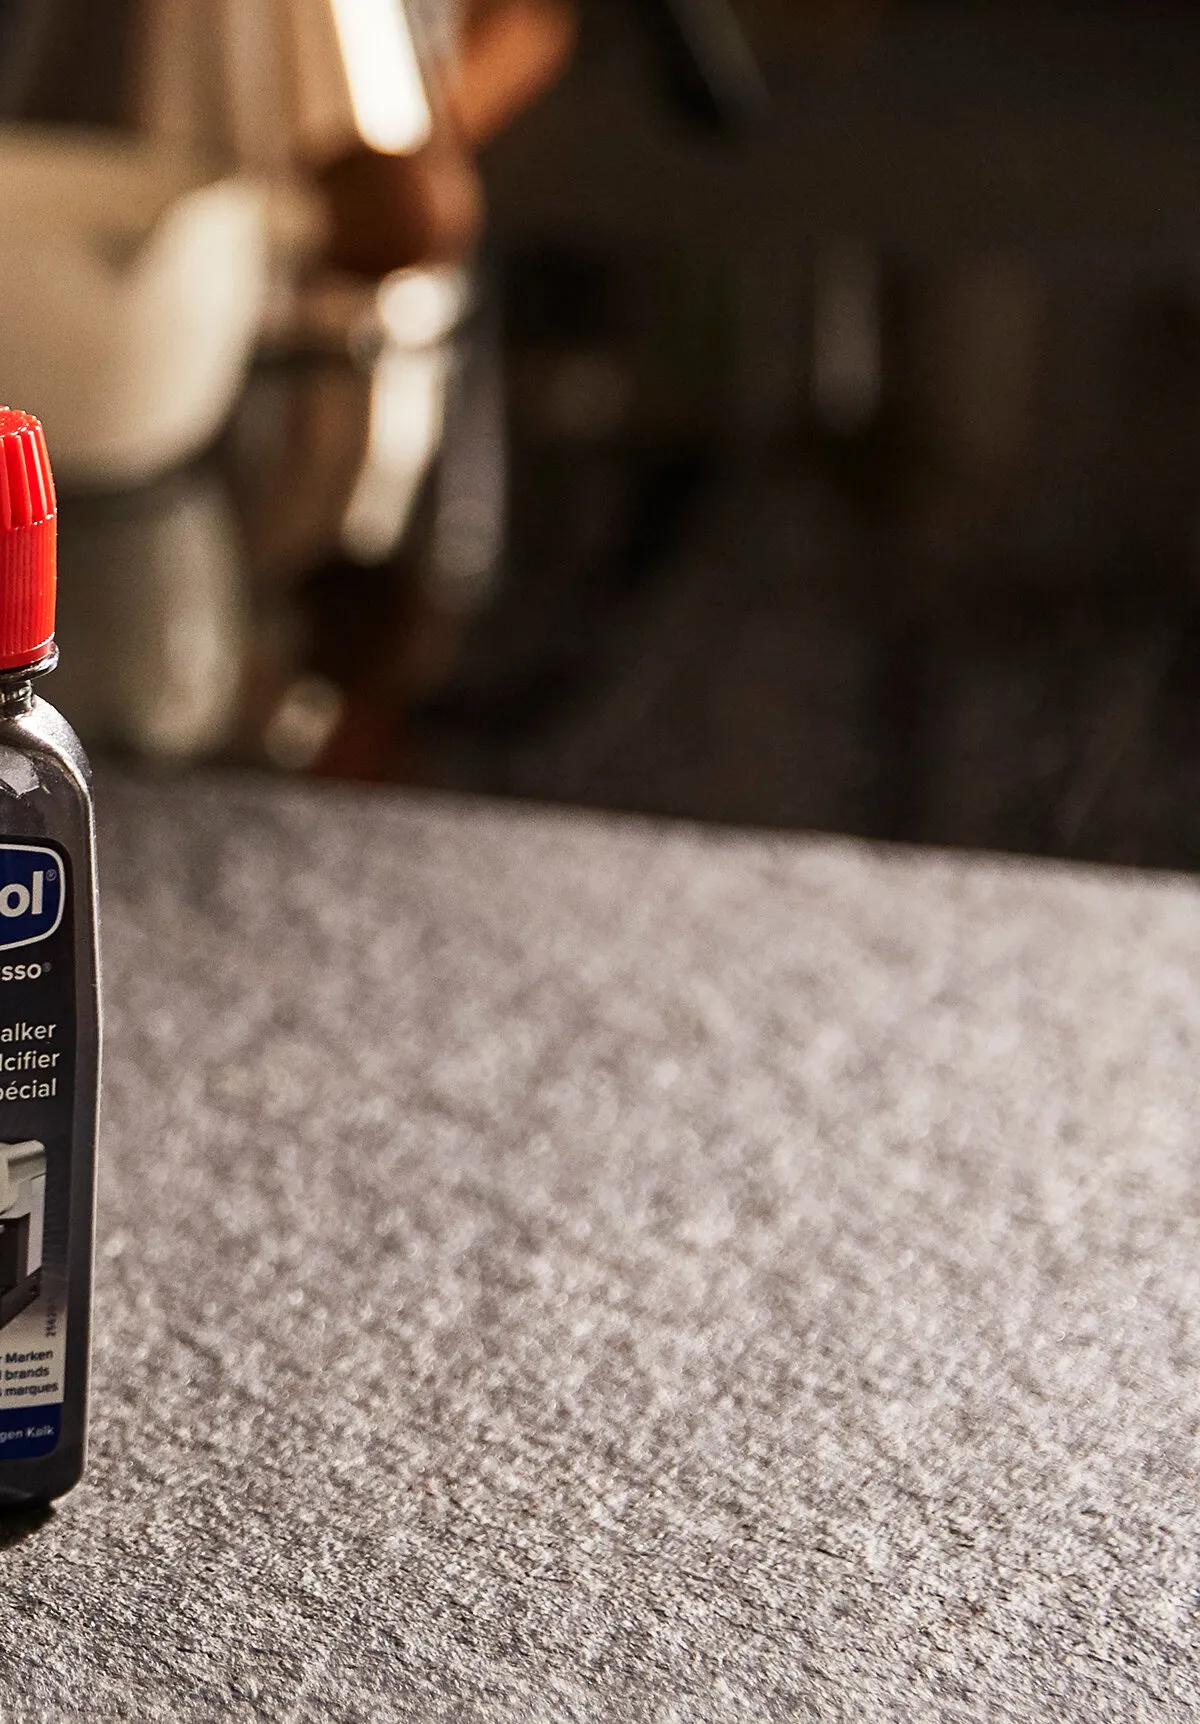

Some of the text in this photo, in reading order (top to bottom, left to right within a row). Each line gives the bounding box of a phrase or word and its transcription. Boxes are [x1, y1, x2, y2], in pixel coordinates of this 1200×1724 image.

[4, 1350, 54, 1364] Marken
[4, 1365, 50, 1381] brands
[5, 1381, 59, 1396] marques
